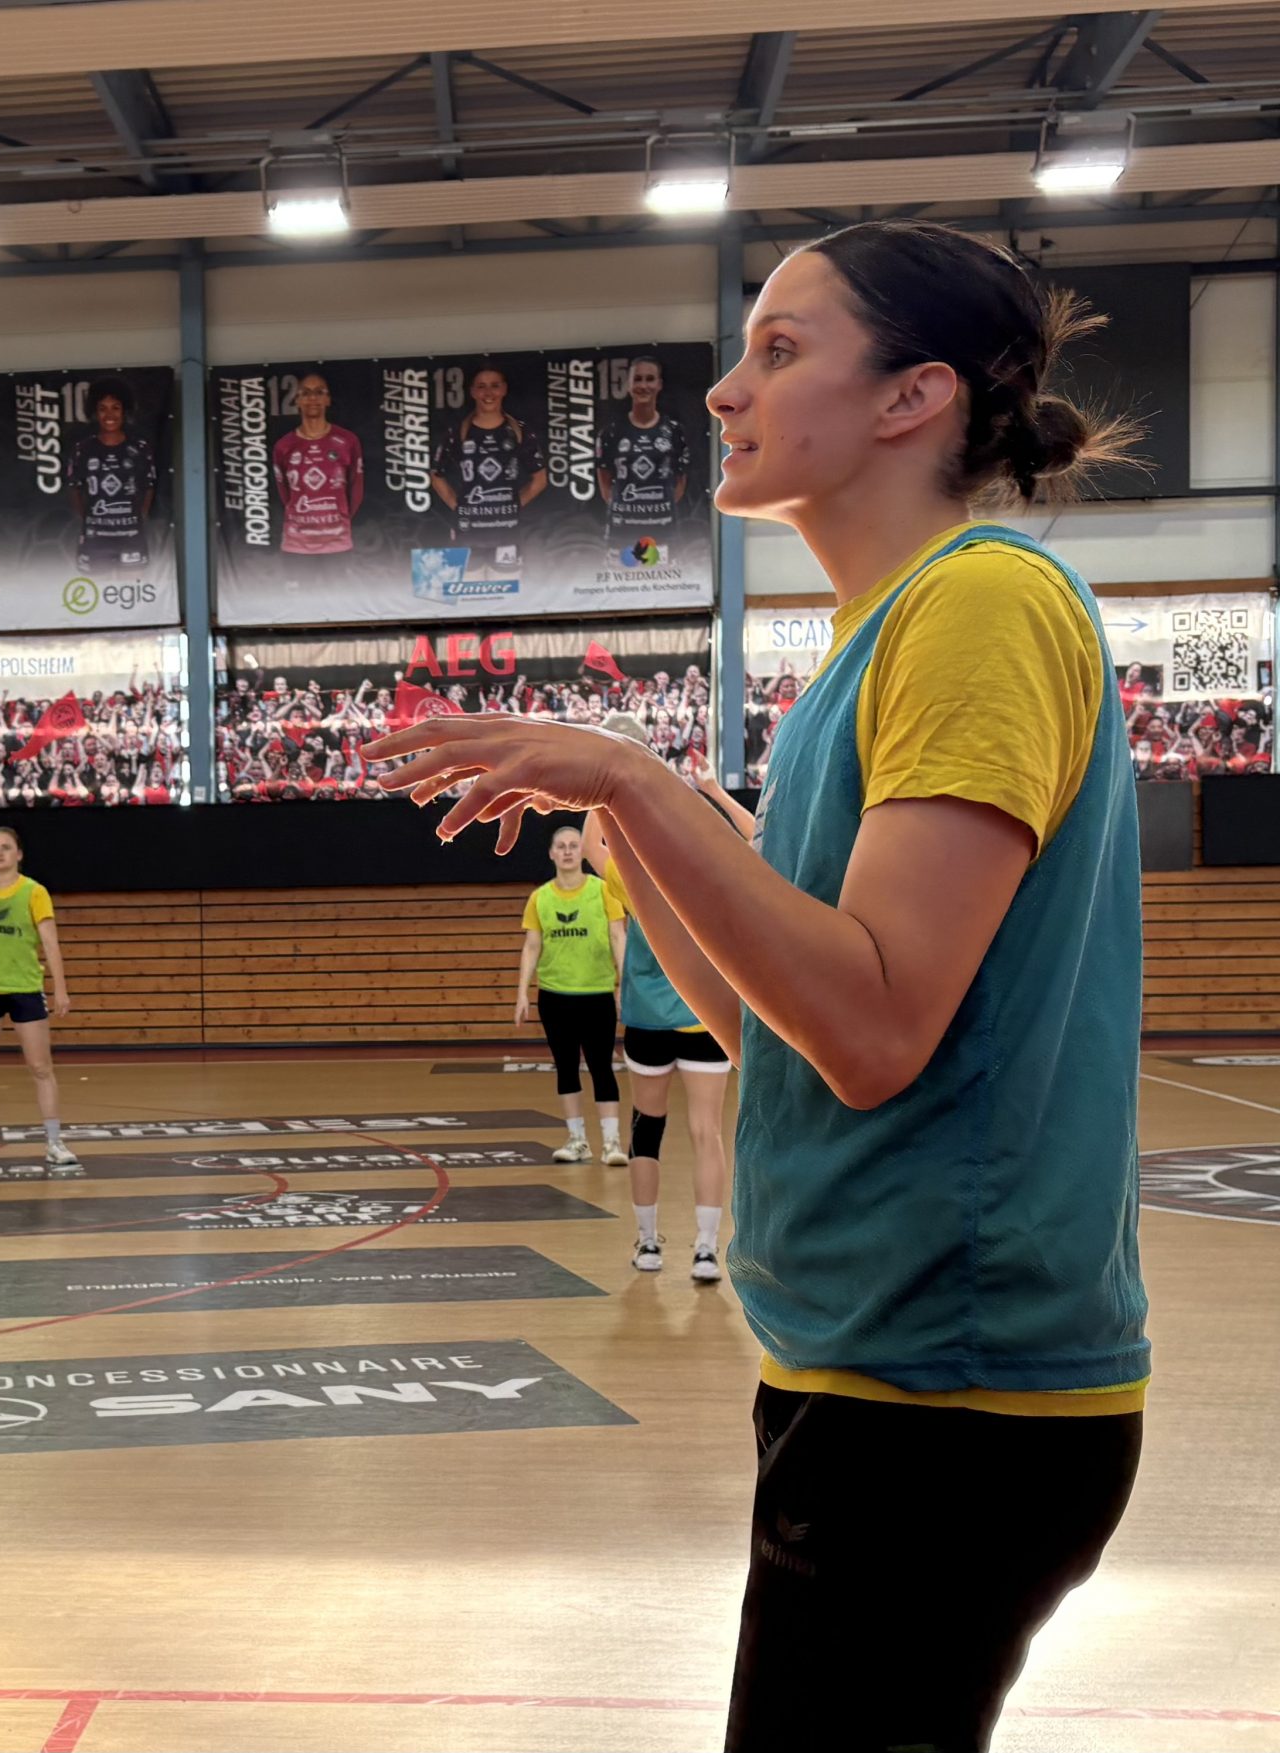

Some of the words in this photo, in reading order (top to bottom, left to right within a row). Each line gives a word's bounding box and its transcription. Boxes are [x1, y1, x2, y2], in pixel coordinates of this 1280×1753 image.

[267, 374, 300, 416] 12
[433, 367, 465, 409] 13
[597, 358, 629, 400] 15
[15, 384, 36, 462] LOUISE
[240, 377, 267, 434] COSTA
[547, 361, 569, 488] CORENTINE
[35, 383, 62, 494] CUSSET
[242, 435, 268, 461] DA
[402, 368, 431, 513] GUERRIER
[568, 359, 596, 501] CAVALIER
[243, 462, 271, 546] RODRIGO
[103, 578, 157, 610] egis
[612, 568, 682, 582] WEIDMANN
[405, 631, 517, 678] AEG
[90, 1376, 544, 1418] SANY
